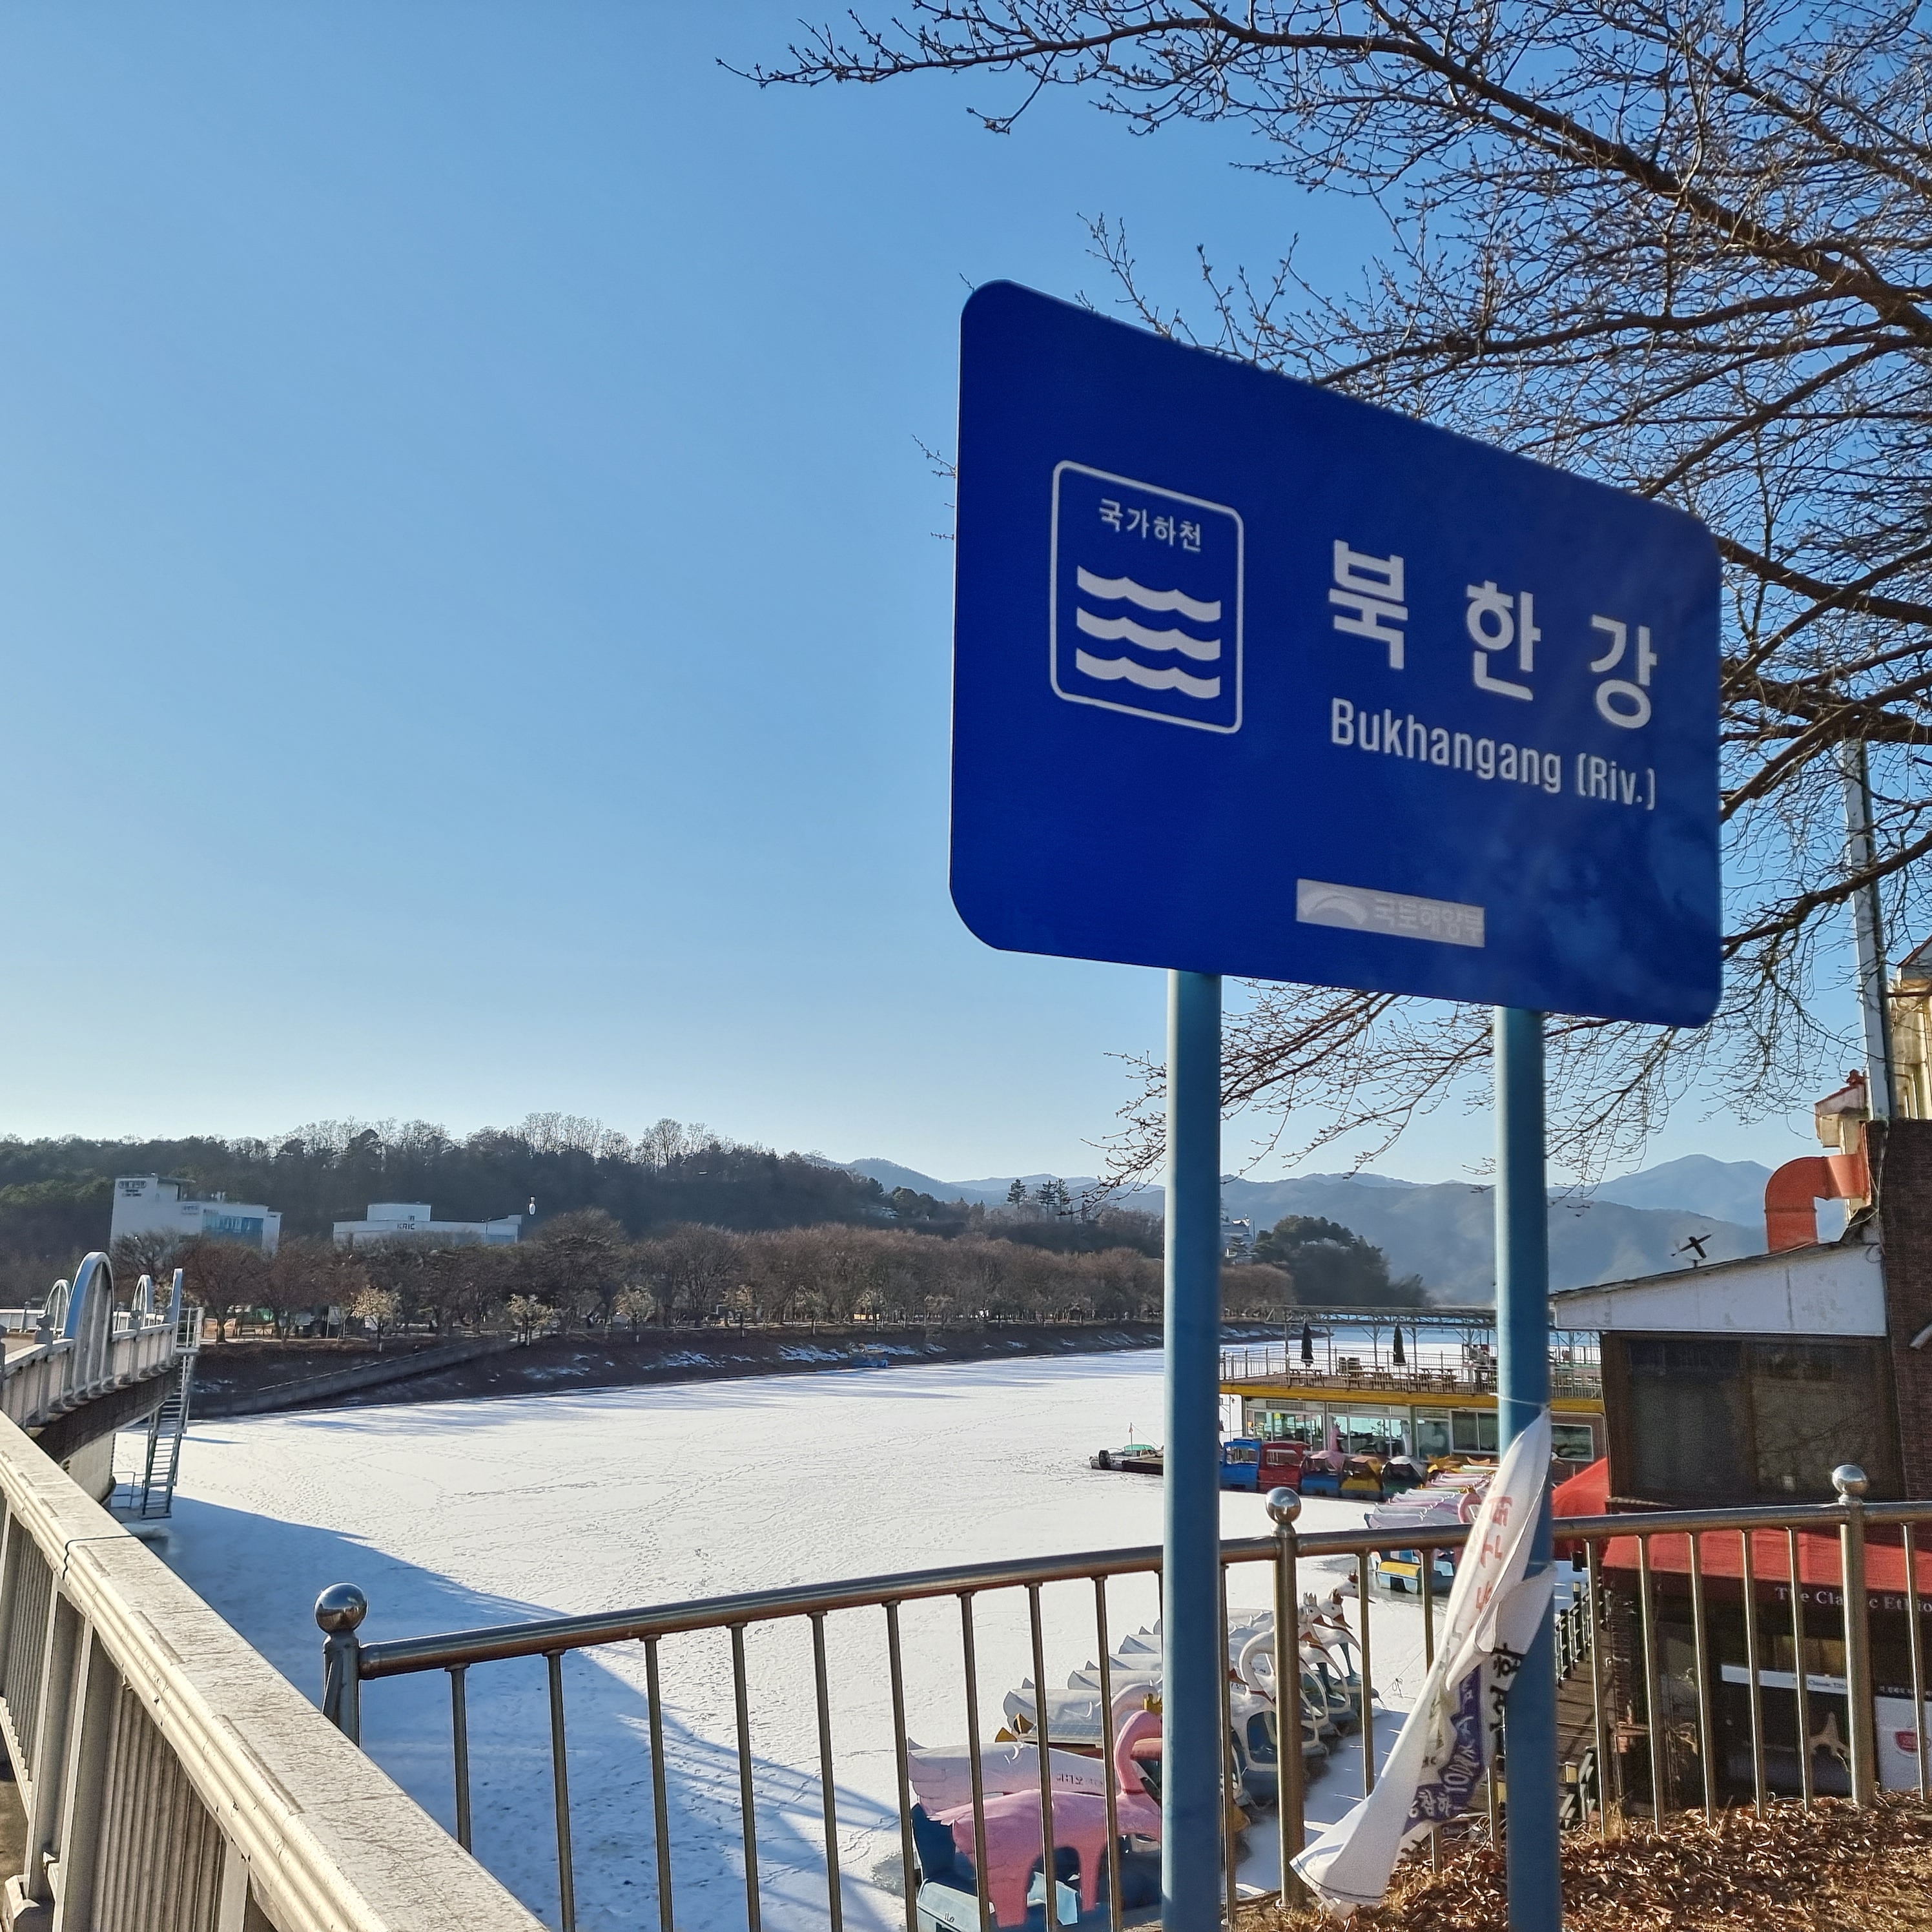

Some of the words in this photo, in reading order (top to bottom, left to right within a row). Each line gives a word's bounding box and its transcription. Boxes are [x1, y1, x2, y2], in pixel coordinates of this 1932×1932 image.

[1098, 497, 1202, 554] 국가하천
[1331, 699, 1562, 794] Bukhangang
[1577, 752, 1656, 811] (Riv.)
[1775, 1587, 1810, 1603] Te
[1815, 1590, 1879, 1609] Clac
